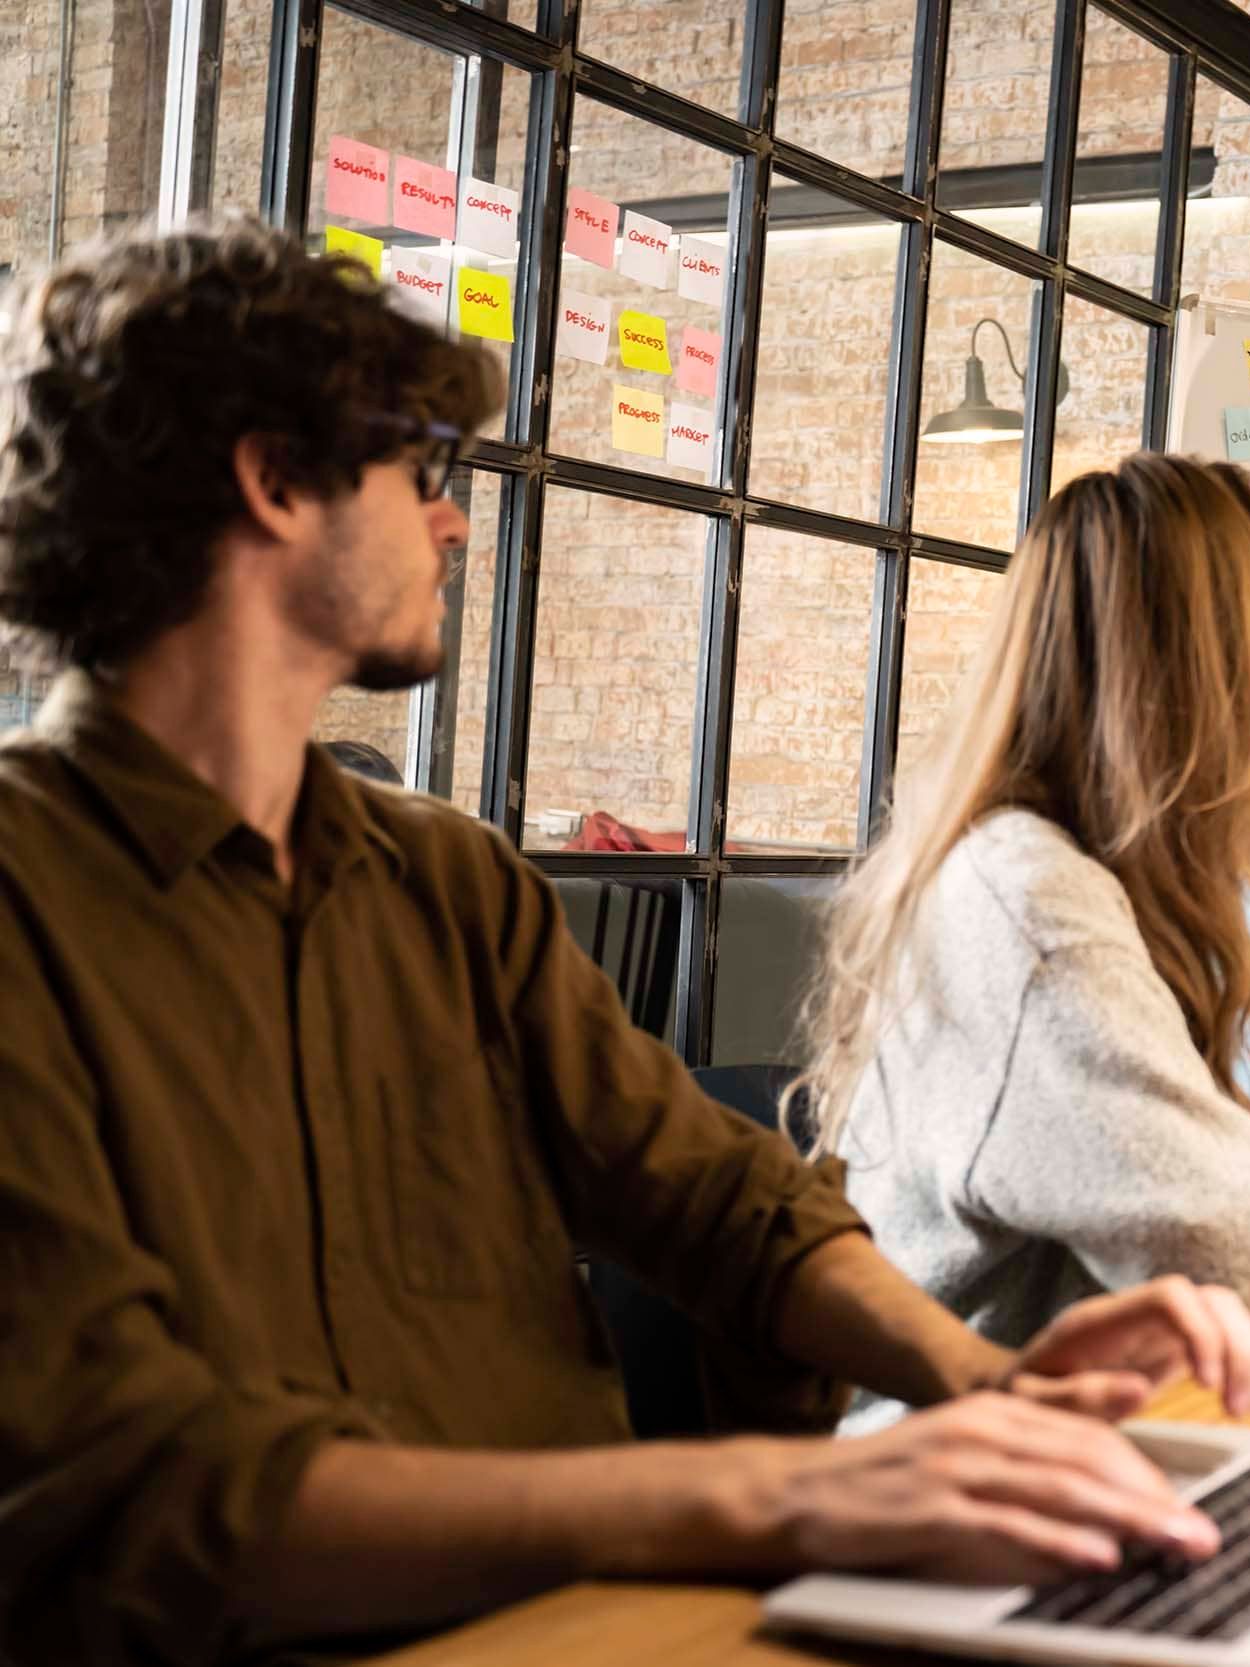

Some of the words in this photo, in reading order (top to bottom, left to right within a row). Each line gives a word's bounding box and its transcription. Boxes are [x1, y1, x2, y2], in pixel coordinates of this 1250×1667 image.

[466, 196, 513, 222] CONCEPT
[574, 207, 610, 233] STYLE
[628, 229, 669, 254] CONCEPT
[396, 270, 444, 297] BUDGET
[463, 287, 500, 309] GOAL
[565, 310, 605, 333] DESIGN
